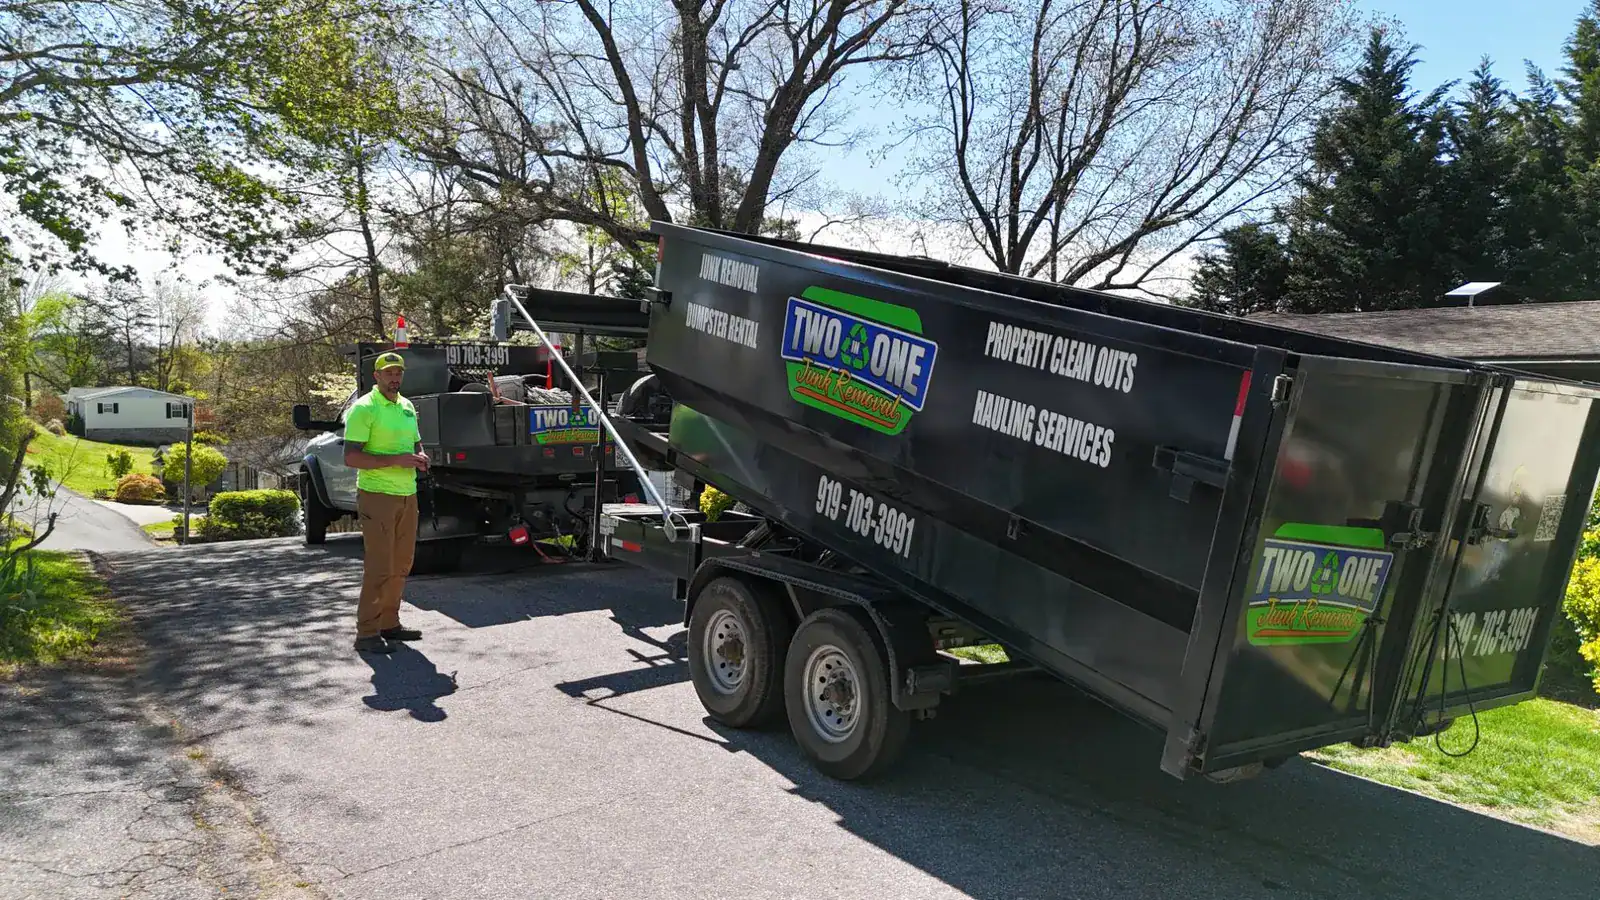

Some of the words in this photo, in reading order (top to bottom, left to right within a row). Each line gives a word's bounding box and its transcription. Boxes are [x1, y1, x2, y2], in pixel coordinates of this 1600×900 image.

[699, 253, 721, 283] JUNK
[719, 258, 760, 294] REMOVAL
[685, 301, 729, 340] DUMPSTER
[727, 314, 760, 349] RENTAL
[792, 306, 842, 359] TWO
[870, 333, 925, 397] ONE
[462, 345, 510, 365] 703-3991
[984, 321, 1053, 370] PROPERTY
[1049, 335, 1097, 383] CLEAN
[1093, 346, 1138, 393] OUTS
[796, 356, 833, 396] Junk
[832, 369, 902, 420] Removal
[534, 408, 569, 429] TWO
[972, 389, 1036, 442] HAULING
[1034, 409, 1115, 468] SERVICES
[816, 475, 915, 559] 919-703-3991
[1256, 547, 1316, 594] TWO
[1337, 556, 1384, 602] ONE
[1257, 597, 1300, 630] Junk
[1299, 598, 1361, 630] Removal
